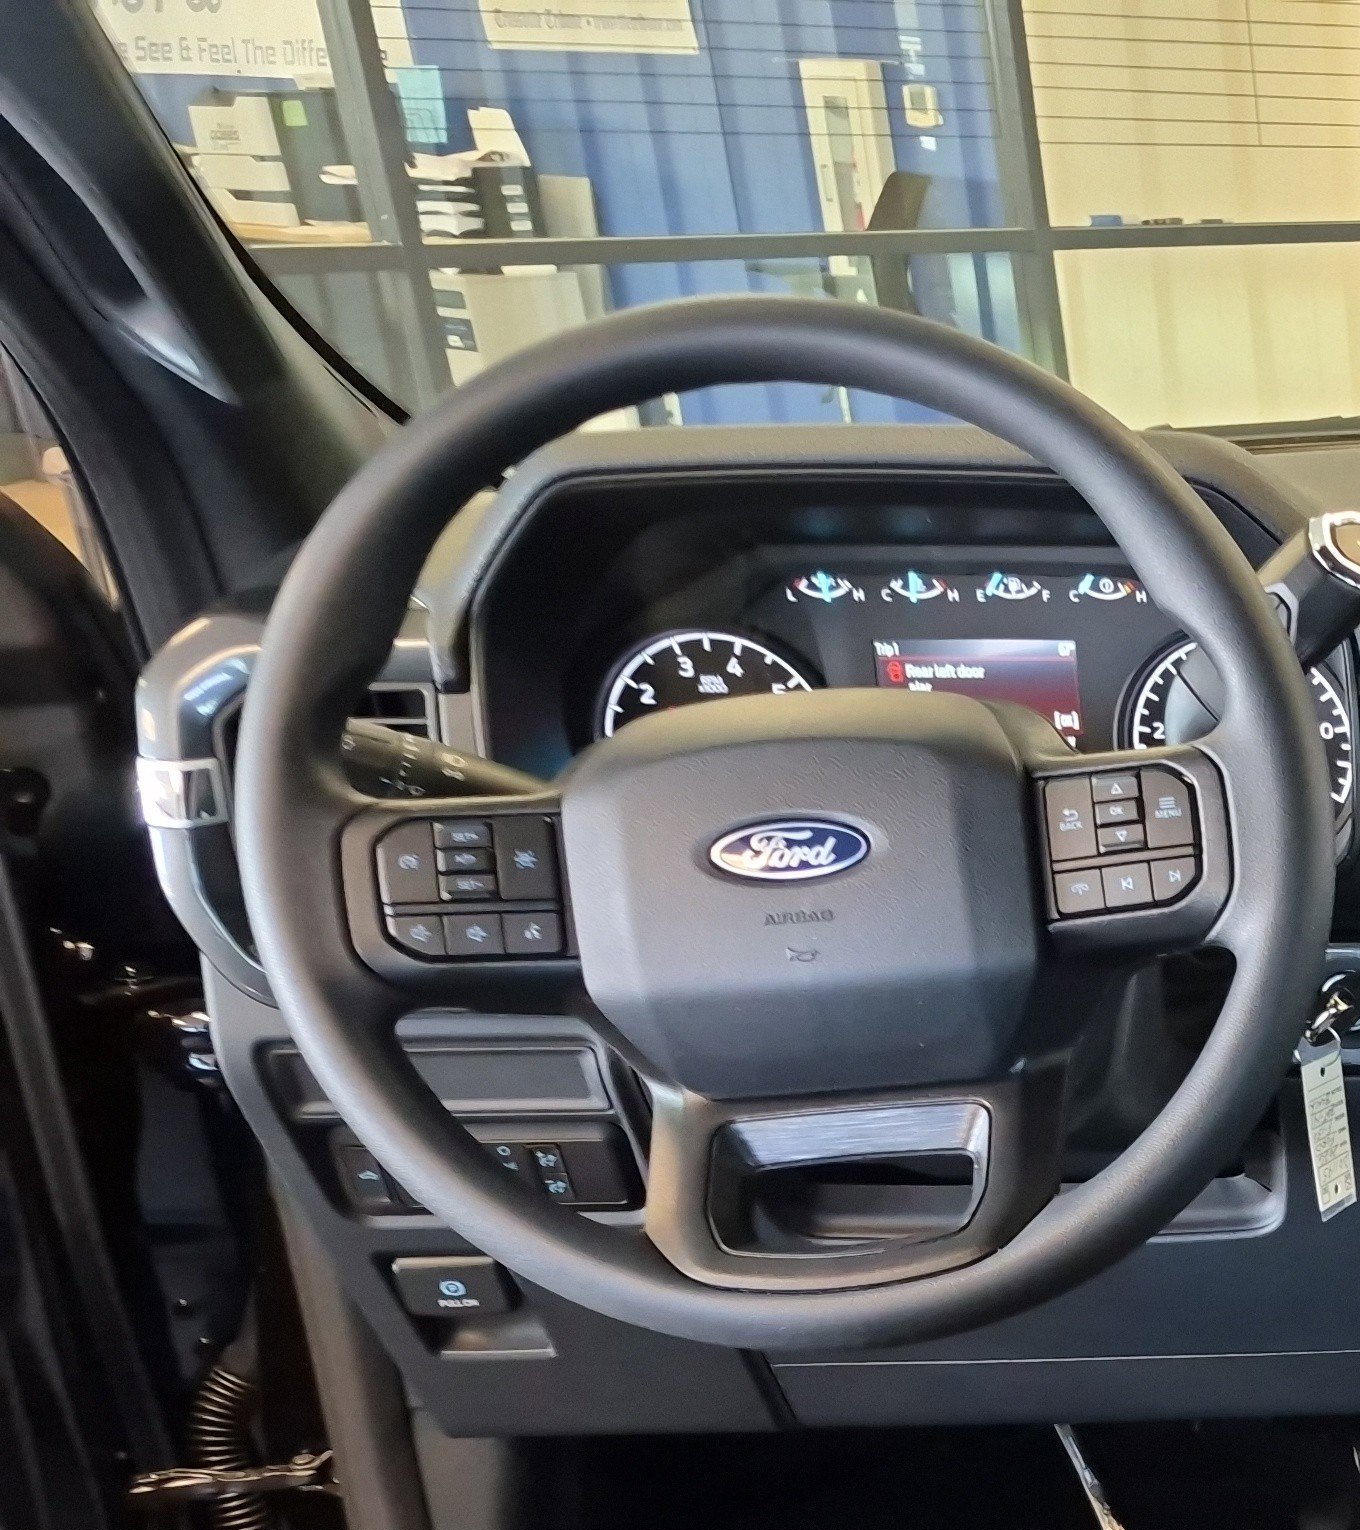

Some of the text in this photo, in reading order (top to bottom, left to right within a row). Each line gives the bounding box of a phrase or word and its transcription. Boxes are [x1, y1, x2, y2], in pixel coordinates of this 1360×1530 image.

[135, 35, 173, 62] See
[178, 37, 193, 62] &
[196, 37, 237, 63] Feel
[241, 39, 277, 65] The
[853, 589, 866, 602] H
[881, 588, 893, 602] C
[948, 589, 960, 602] H
[976, 589, 987, 602] E
[1042, 589, 1051, 602] F
[1069, 589, 1080, 602] C
[1135, 589, 1148, 603] H
[677, 656, 694, 677] 3
[726, 656, 745, 677] 4
[904, 662, 985, 678] Rear left door
[638, 682, 657, 705] 2
[1155, 808, 1182, 819] MENU
[744, 829, 838, 870] Ford
[764, 909, 835, 926] AIRBAG
